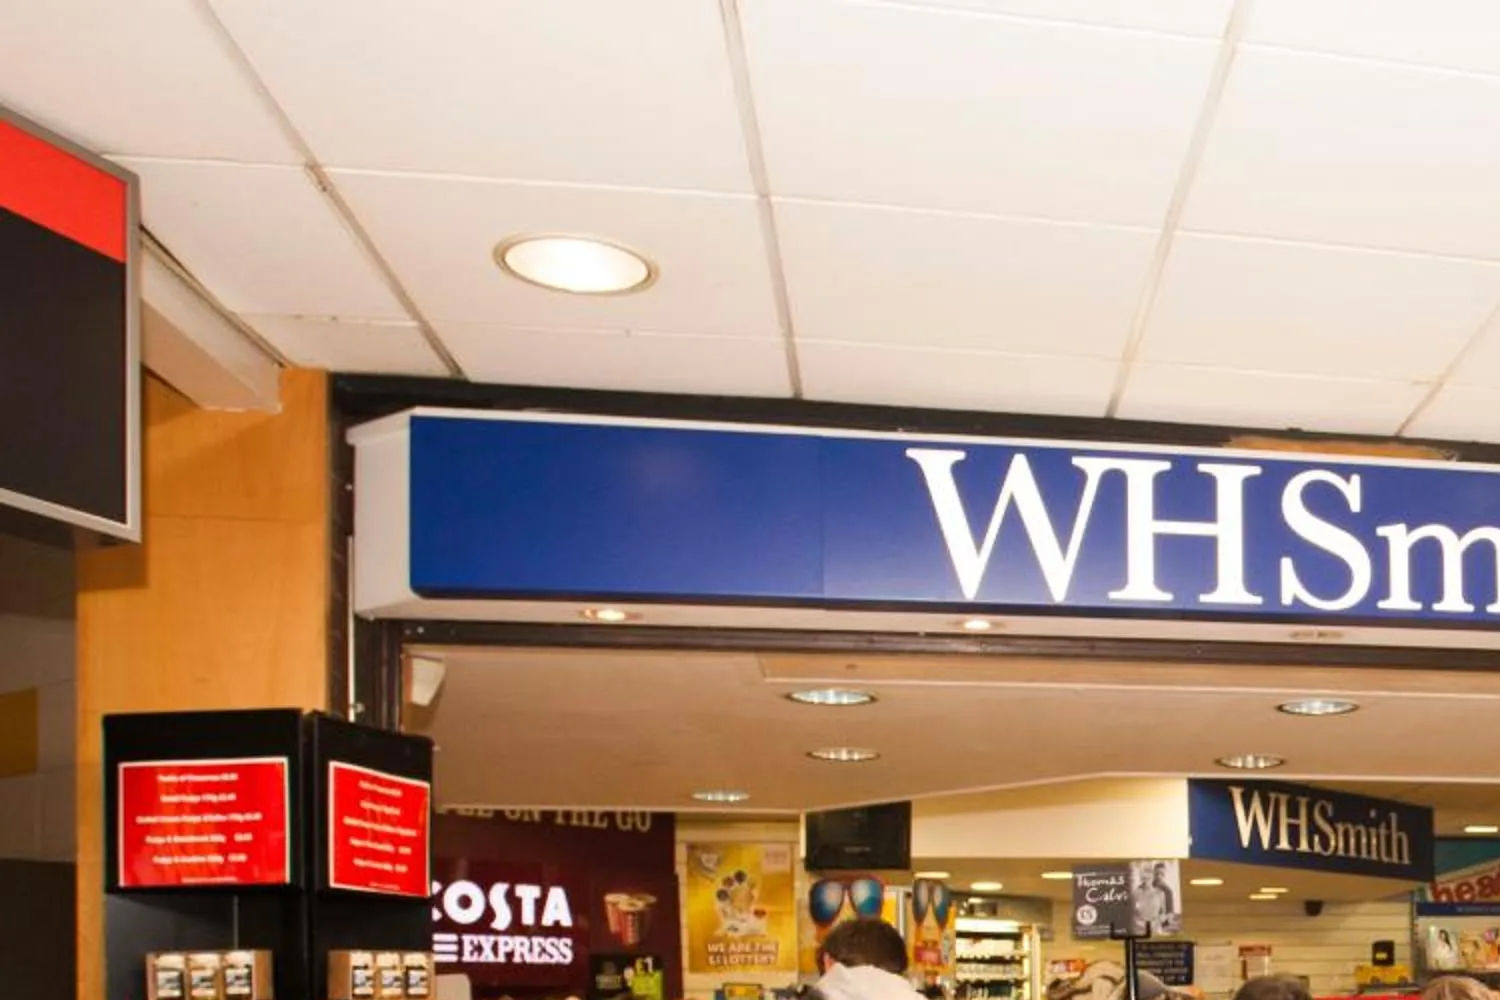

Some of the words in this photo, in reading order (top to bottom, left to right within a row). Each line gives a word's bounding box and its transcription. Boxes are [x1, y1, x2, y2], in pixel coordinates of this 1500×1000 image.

[1228, 785, 1412, 866] WHSmith
[432, 879, 574, 931] OSTA
[461, 933, 574, 965] EXPRESS
